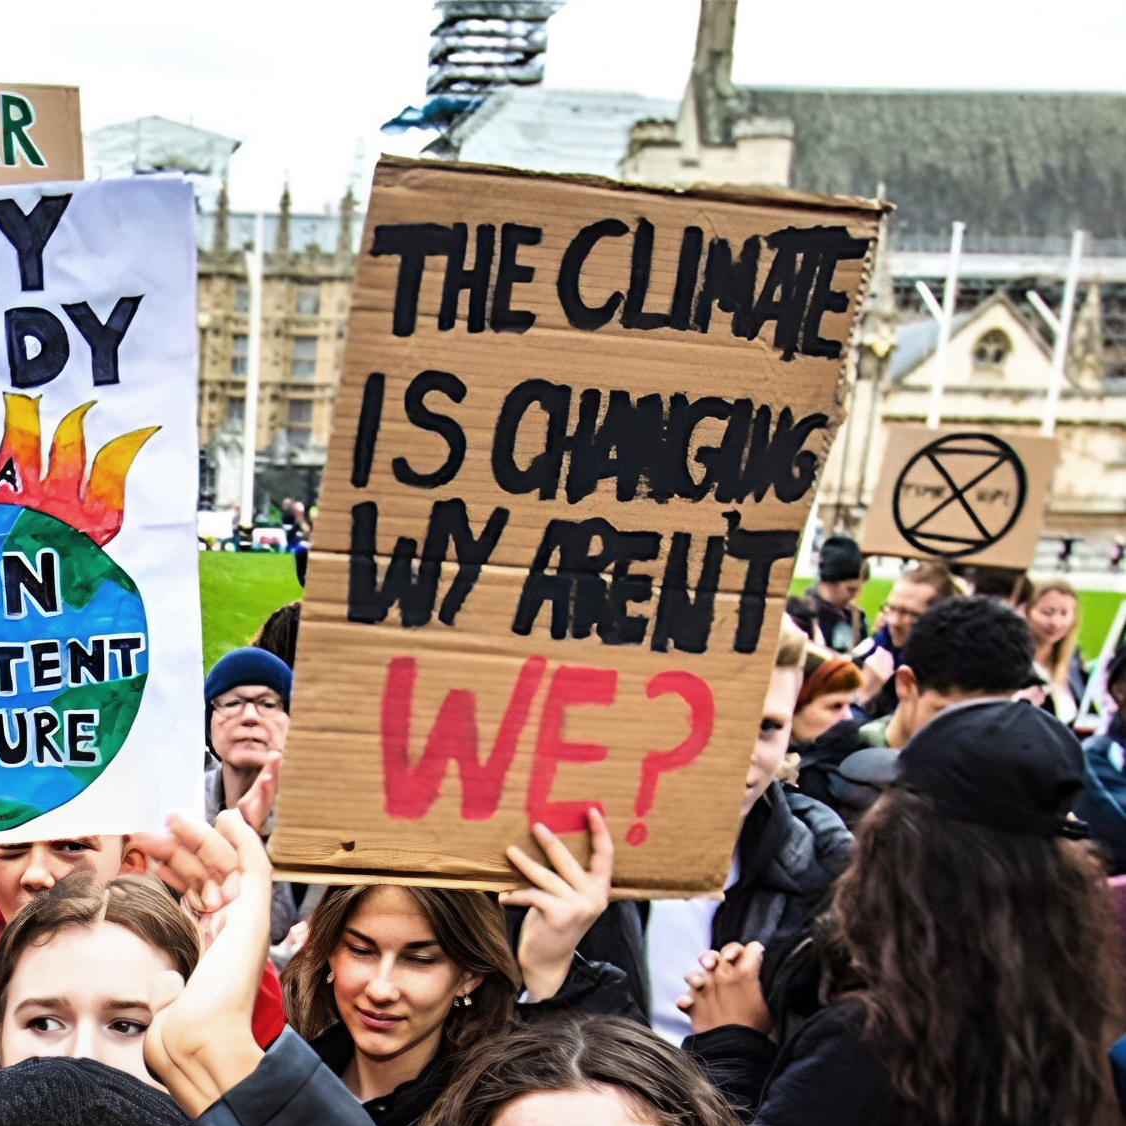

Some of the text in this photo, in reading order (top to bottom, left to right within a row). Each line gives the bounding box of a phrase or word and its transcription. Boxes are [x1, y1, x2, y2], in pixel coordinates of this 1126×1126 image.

[368, 216, 872, 361] THE CLIMATE
[351, 369, 829, 504] IS CHANGING
[511, 509, 800, 654] AREN'T
[378, 654, 715, 847] WE?
